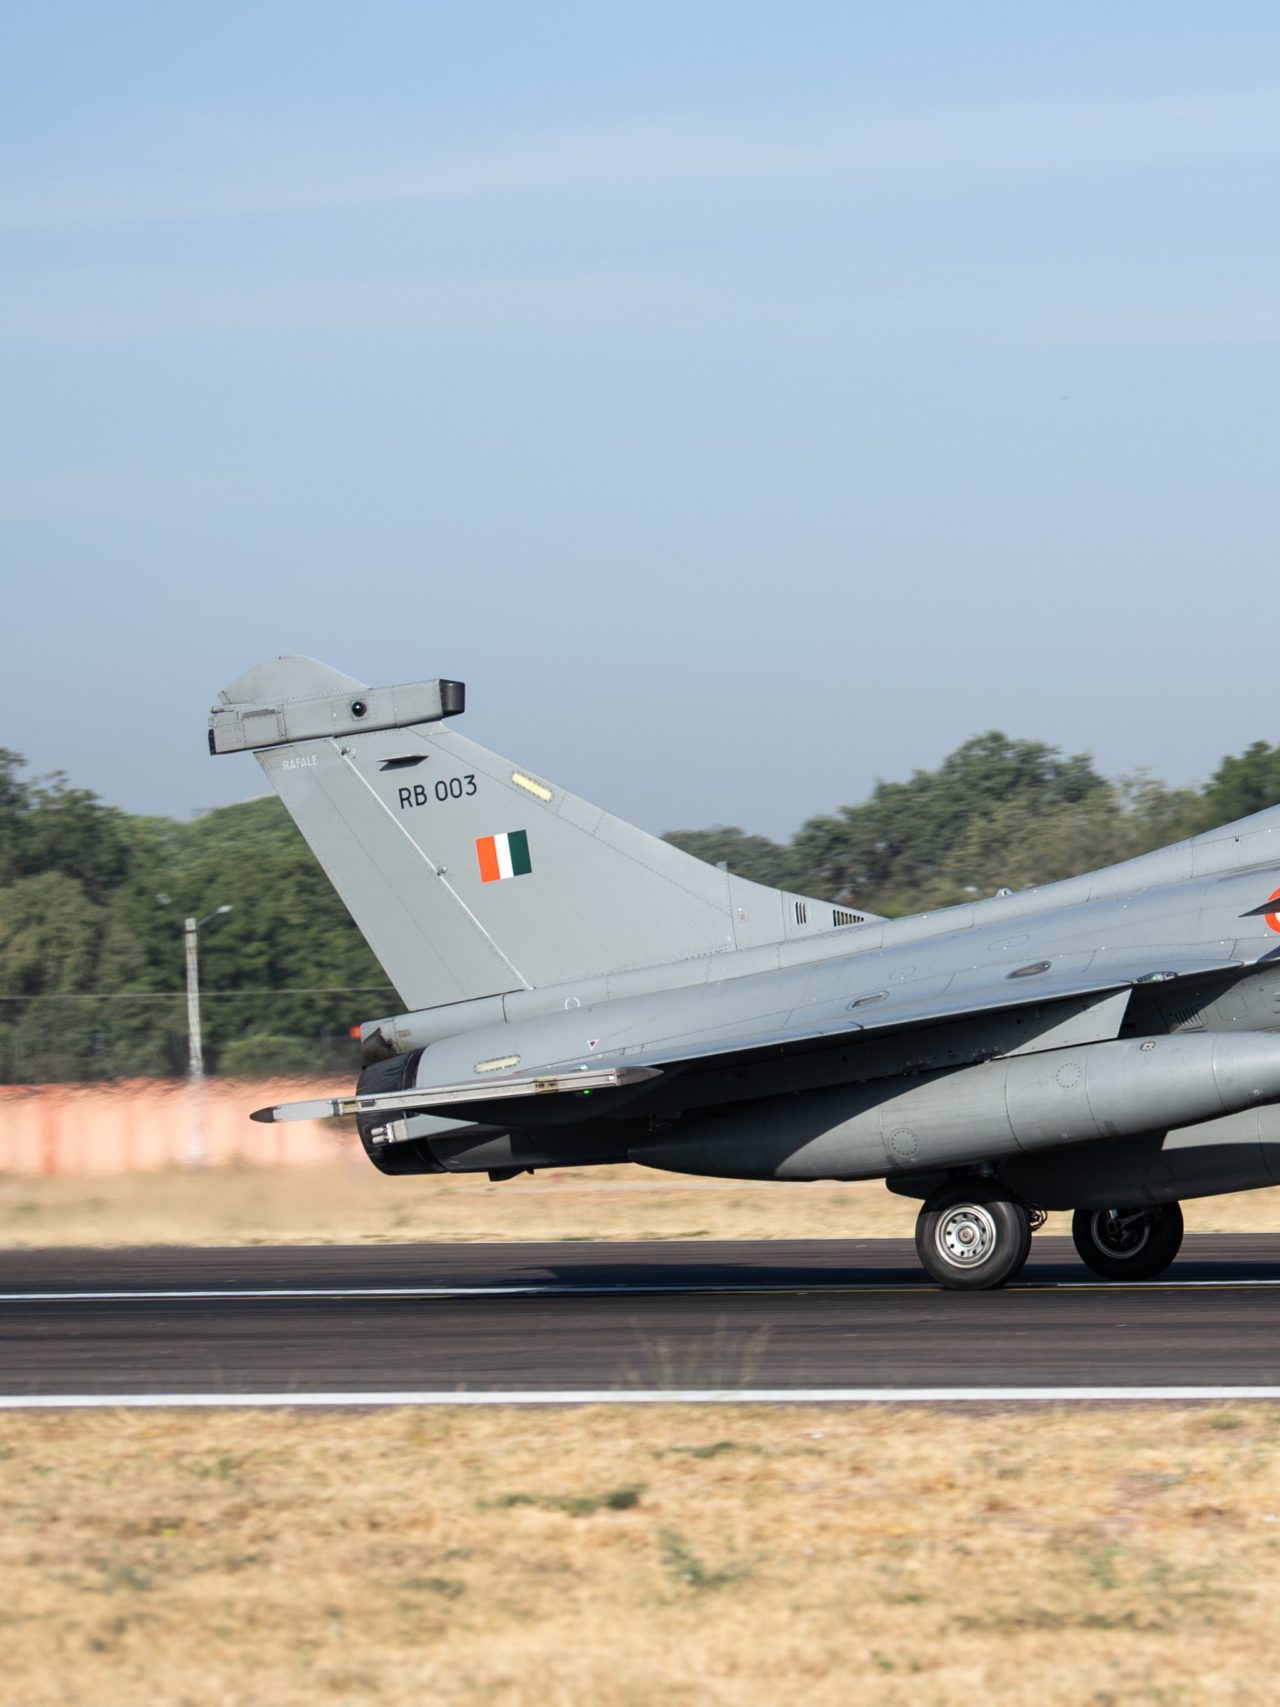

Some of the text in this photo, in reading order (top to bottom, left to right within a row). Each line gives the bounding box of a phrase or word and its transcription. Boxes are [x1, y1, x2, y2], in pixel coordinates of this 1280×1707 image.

[282, 755, 318, 771] RAFALE
[399, 774, 477, 809] RB 003
